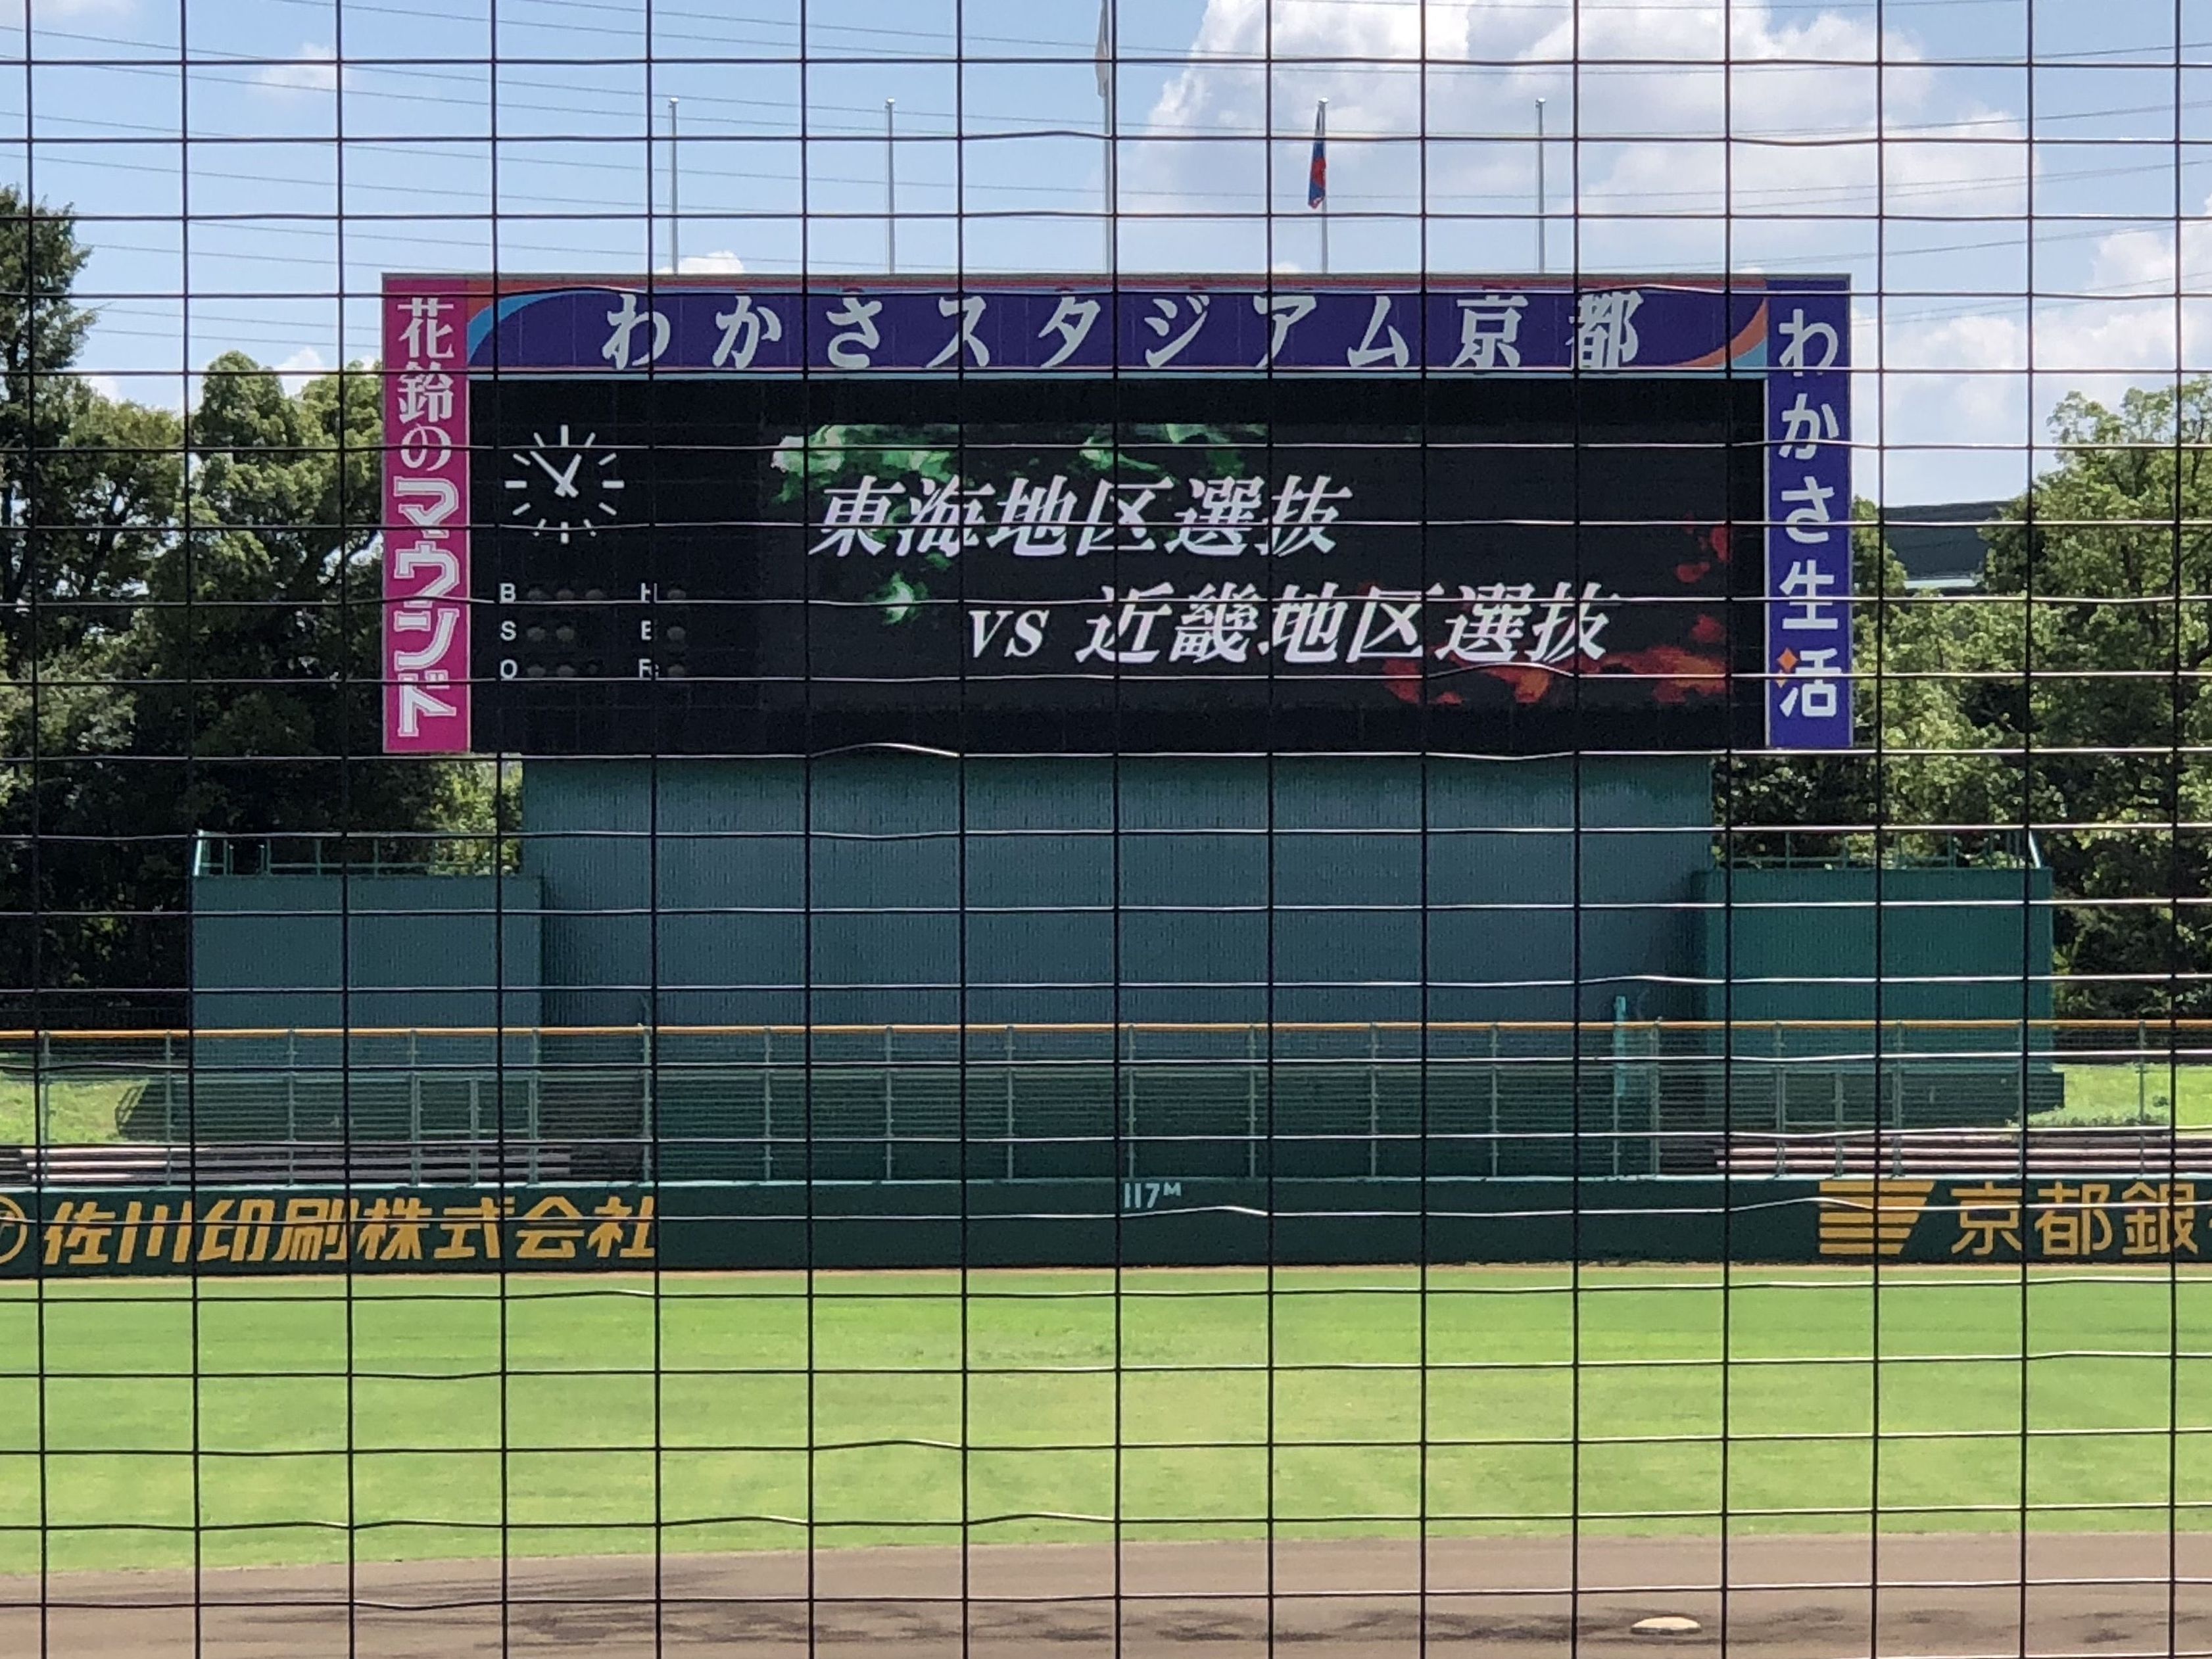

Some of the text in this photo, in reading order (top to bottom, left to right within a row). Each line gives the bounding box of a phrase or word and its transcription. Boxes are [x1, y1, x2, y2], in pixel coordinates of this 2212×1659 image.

[602, 291, 1644, 369] わかさスタジアム京都
[393, 297, 460, 737] 花鈴のマウンド
[808, 475, 1353, 557] 東海地区選抜
[1778, 308, 1842, 717] わかさ生活
[499, 583, 516, 604] B
[500, 620, 517, 641] S
[1074, 581, 1623, 664] 近畿地区選抜
[43, 1195, 655, 1265] 佐川印刷株式会社
[1950, 1181, 2212, 1256] 京都銀
